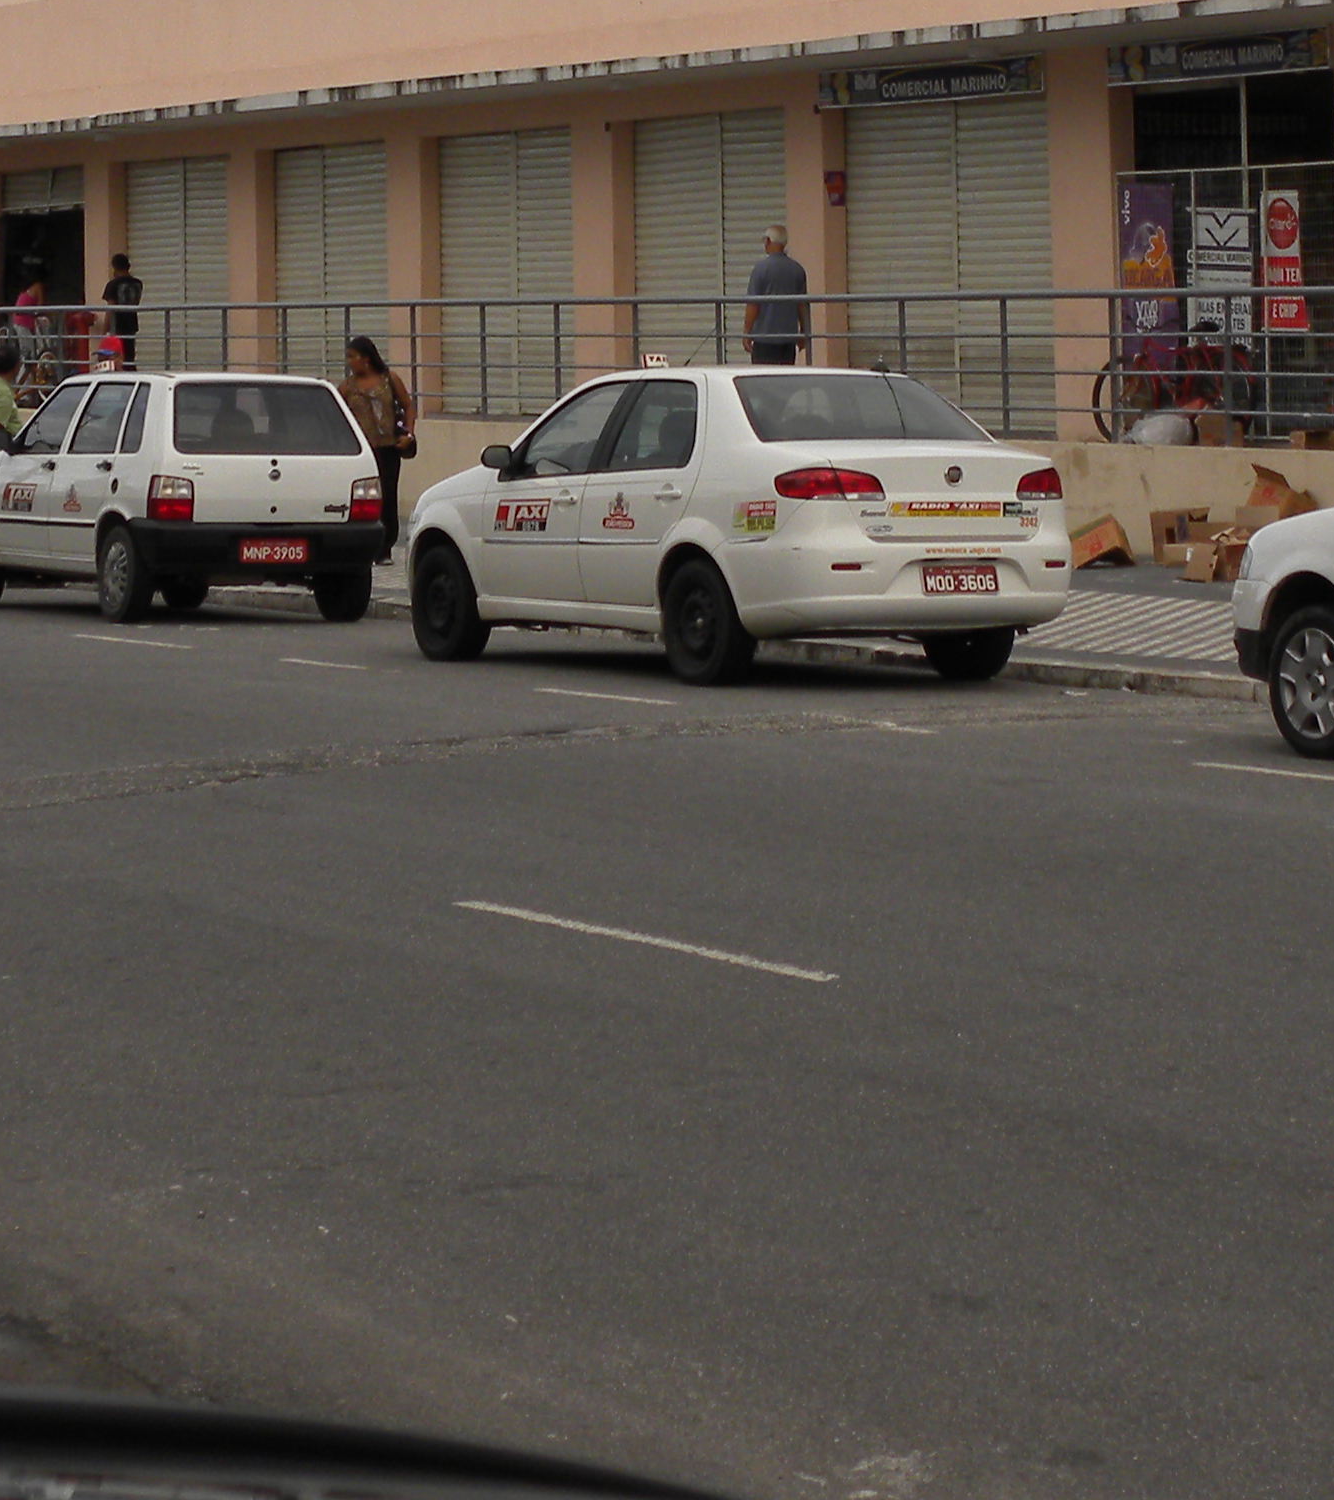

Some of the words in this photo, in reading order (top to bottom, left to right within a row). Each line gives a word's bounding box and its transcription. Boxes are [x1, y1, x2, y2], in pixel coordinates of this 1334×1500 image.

[1182, 49, 1236, 69] COMERCIAL
[1237, 43, 1284, 64] MARINHO
[882, 80, 947, 99] COMERCIAL
[951, 73, 1006, 93] MARINHO
[9, 485, 37, 509] TAXI
[500, 501, 549, 530] TAXI
